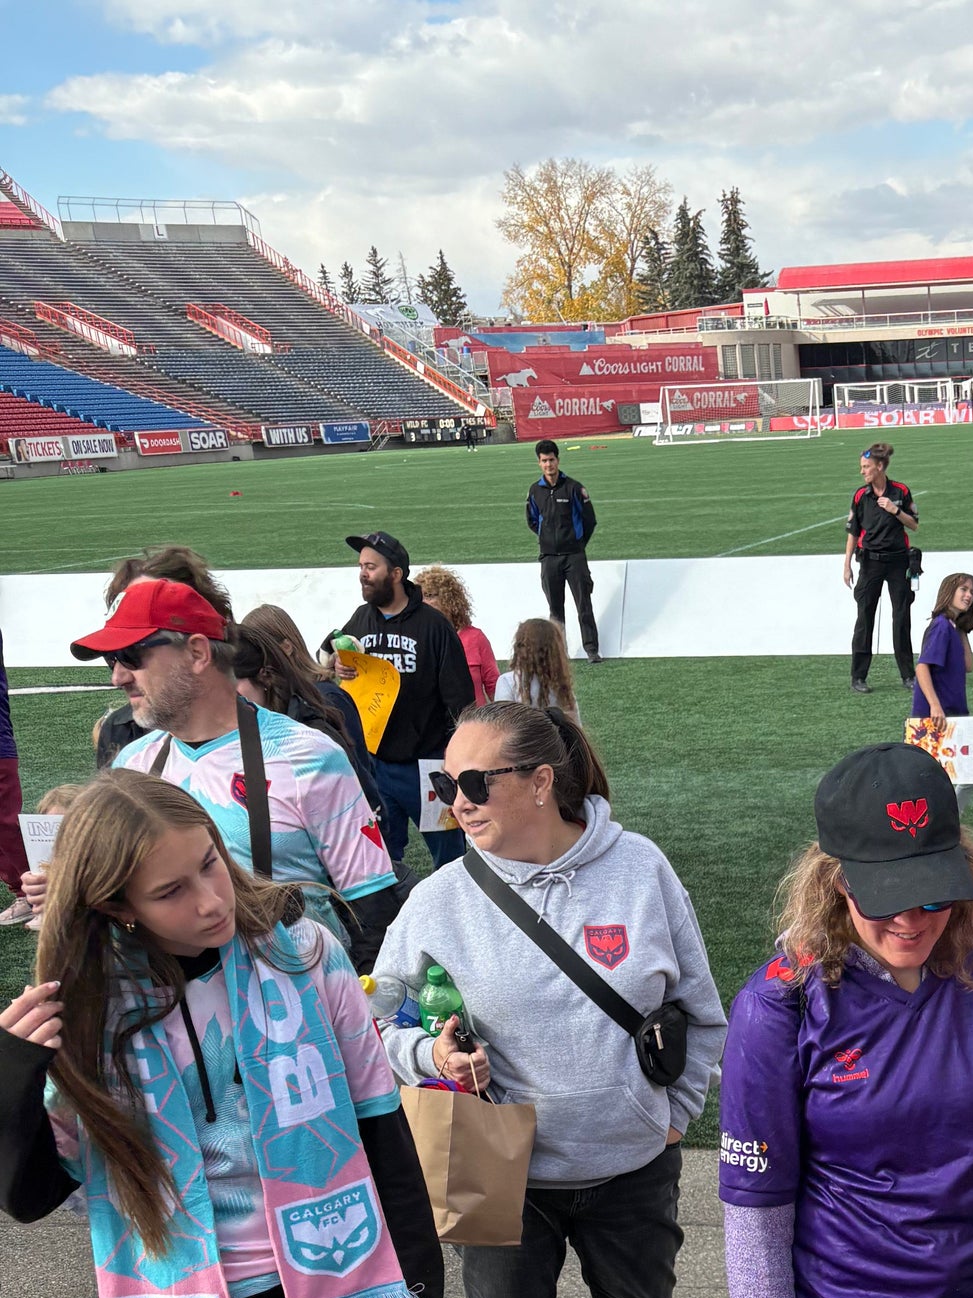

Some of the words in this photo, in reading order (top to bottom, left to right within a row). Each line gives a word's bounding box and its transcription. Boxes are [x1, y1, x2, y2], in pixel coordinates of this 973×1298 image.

[917, 328, 944, 337] OLYMPIC
[593, 358, 630, 375] Coors
[630, 361, 662, 374] LIGHT
[665, 355, 705, 373] CORRAL
[555, 397, 603, 416] CORRAL
[693, 390, 736, 408] CORRAL
[863, 409, 935, 427] SOAR
[191, 431, 227, 449] SOAR
[269, 427, 296, 444] WITH
[296, 427, 309, 443] US
[27, 440, 62, 457] TICKETS
[71, 440, 83, 455] ON
[82, 440, 98, 454] SALE
[97, 439, 114, 453] NOW
[386, 633, 418, 654] YORK
[247, 961, 336, 1128] BO
[832, 1068, 869, 1083] hummel
[289, 1190, 361, 1222] CALGARY
[322, 1215, 340, 1228] FC
